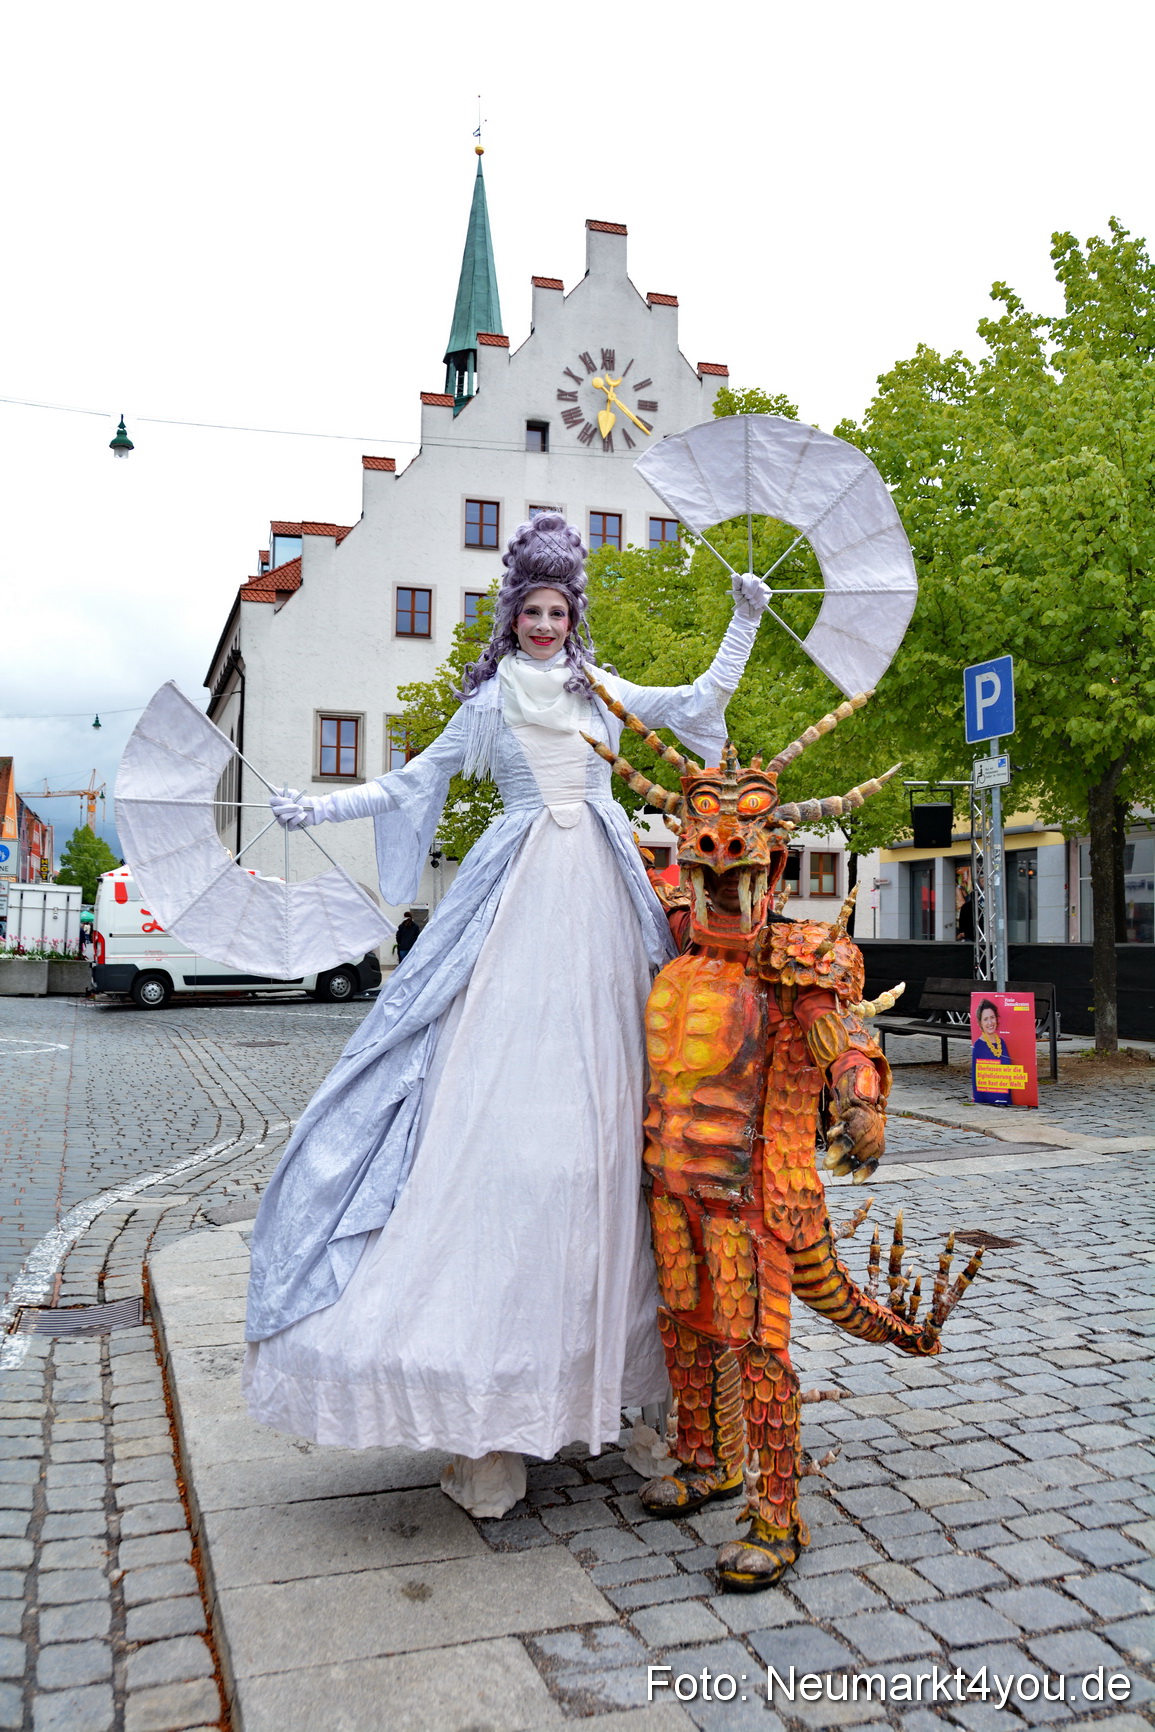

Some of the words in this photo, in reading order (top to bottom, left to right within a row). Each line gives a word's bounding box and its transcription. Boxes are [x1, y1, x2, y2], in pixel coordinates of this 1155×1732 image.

[578, 351, 598, 375] XI
[600, 347, 616, 371] XII
[562, 366, 584, 386] X
[632, 377, 653, 392] II
[556, 388, 579, 402] IX
[637, 399, 659, 412] III
[560, 405, 586, 430] VIII
[576, 421, 598, 447] VII
[621, 427, 637, 449] V
[975, 671, 1001, 731] P
[977, 1064, 1002, 1072] Überlassen
[977, 1072, 1012, 1081] Digitalisierung
